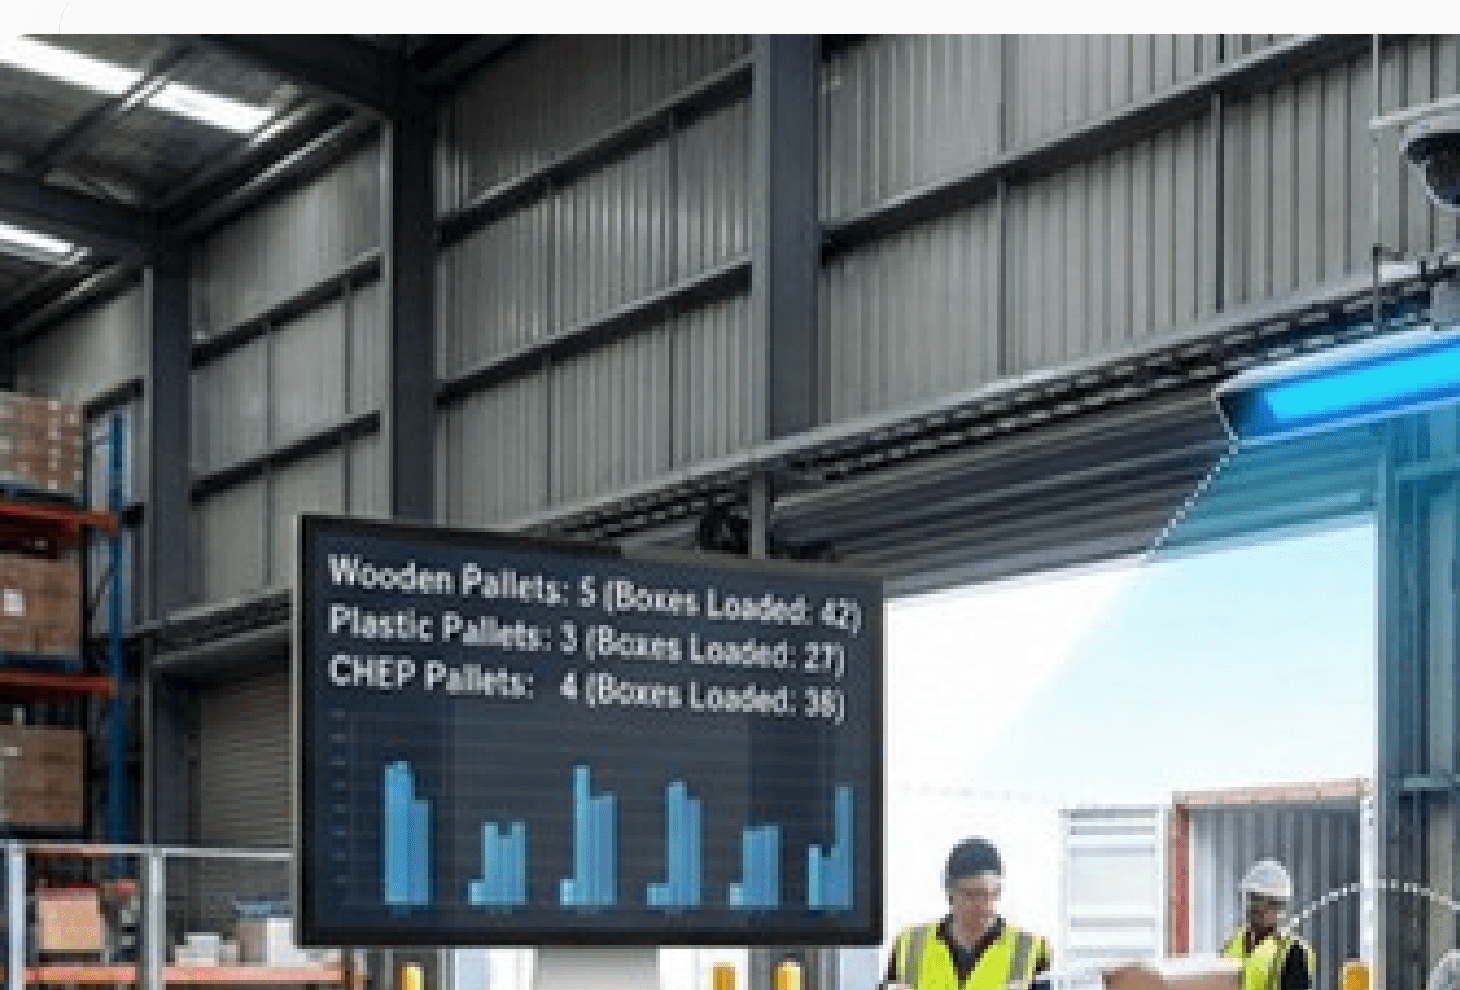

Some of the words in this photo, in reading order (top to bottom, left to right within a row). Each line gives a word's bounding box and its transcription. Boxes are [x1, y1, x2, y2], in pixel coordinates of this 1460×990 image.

[328, 553, 455, 594] Wooden
[462, 562, 569, 607] Pallets:
[577, 575, 596, 607] 5
[603, 580, 700, 616] (Boxes
[707, 588, 814, 625] Loaded:
[821, 597, 862, 638] 42)
[328, 602, 434, 642] Plastic
[441, 610, 552, 651] Pallets:
[559, 620, 578, 654] 3
[585, 624, 682, 661] (Boxes
[690, 632, 797, 668] Loaded:
[804, 640, 845, 681] 27)
[328, 652, 416, 688] CHEP
[423, 659, 534, 699] Pallets:
[559, 672, 578, 700] 4
[585, 672, 682, 708] (Boxes
[690, 680, 797, 713] Loaded:
